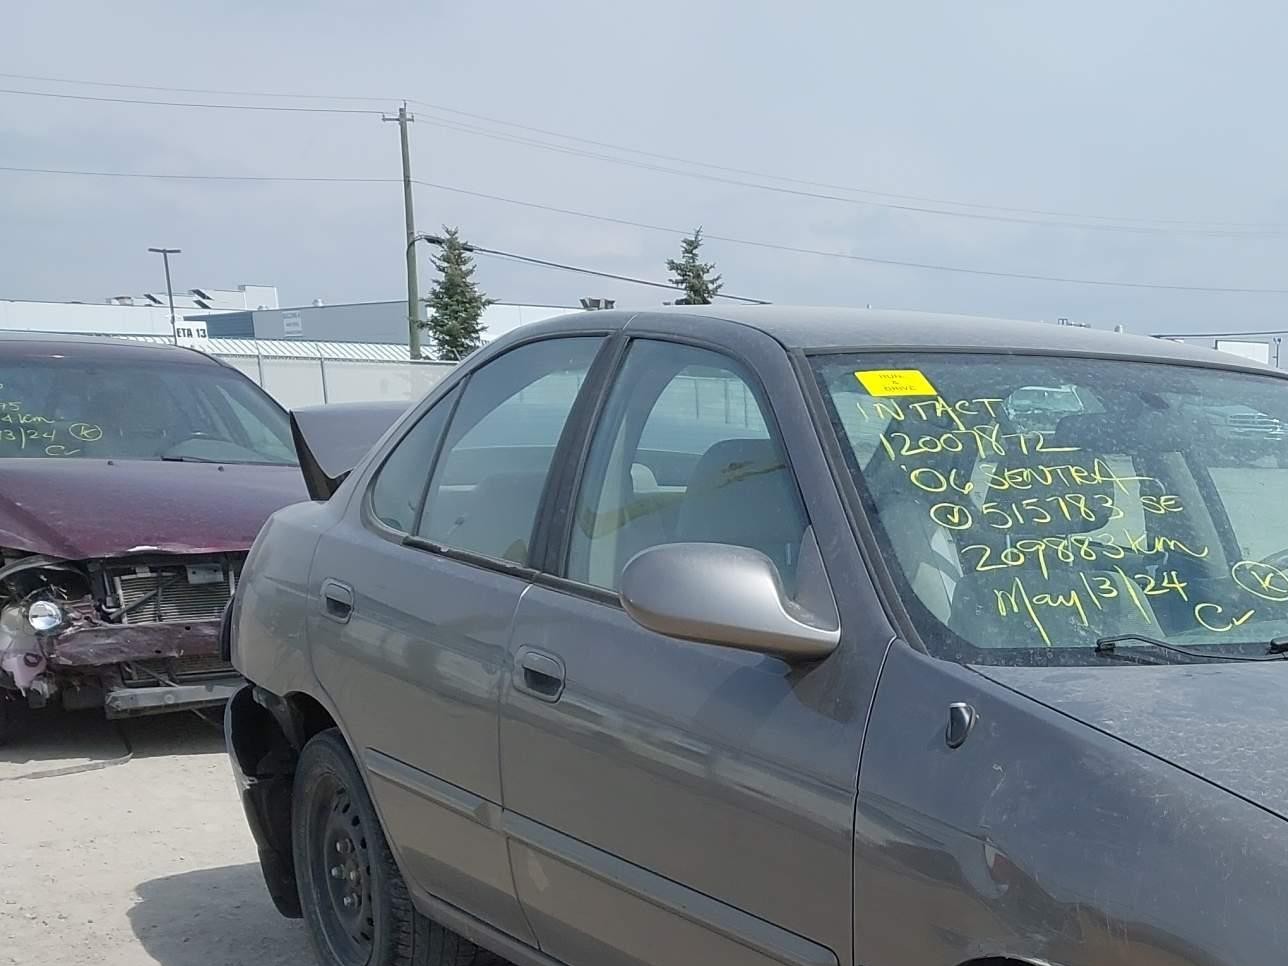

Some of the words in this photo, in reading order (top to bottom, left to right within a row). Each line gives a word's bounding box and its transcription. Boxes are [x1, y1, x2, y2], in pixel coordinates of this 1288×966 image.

[176, 328, 193, 338] ETA
[196, 328, 207, 338] 13
[856, 396, 1003, 432] INTACT
[879, 423, 1081, 461] 12007872
[979, 458, 1167, 497] SENTRA
[1140, 495, 1184, 514] SE
